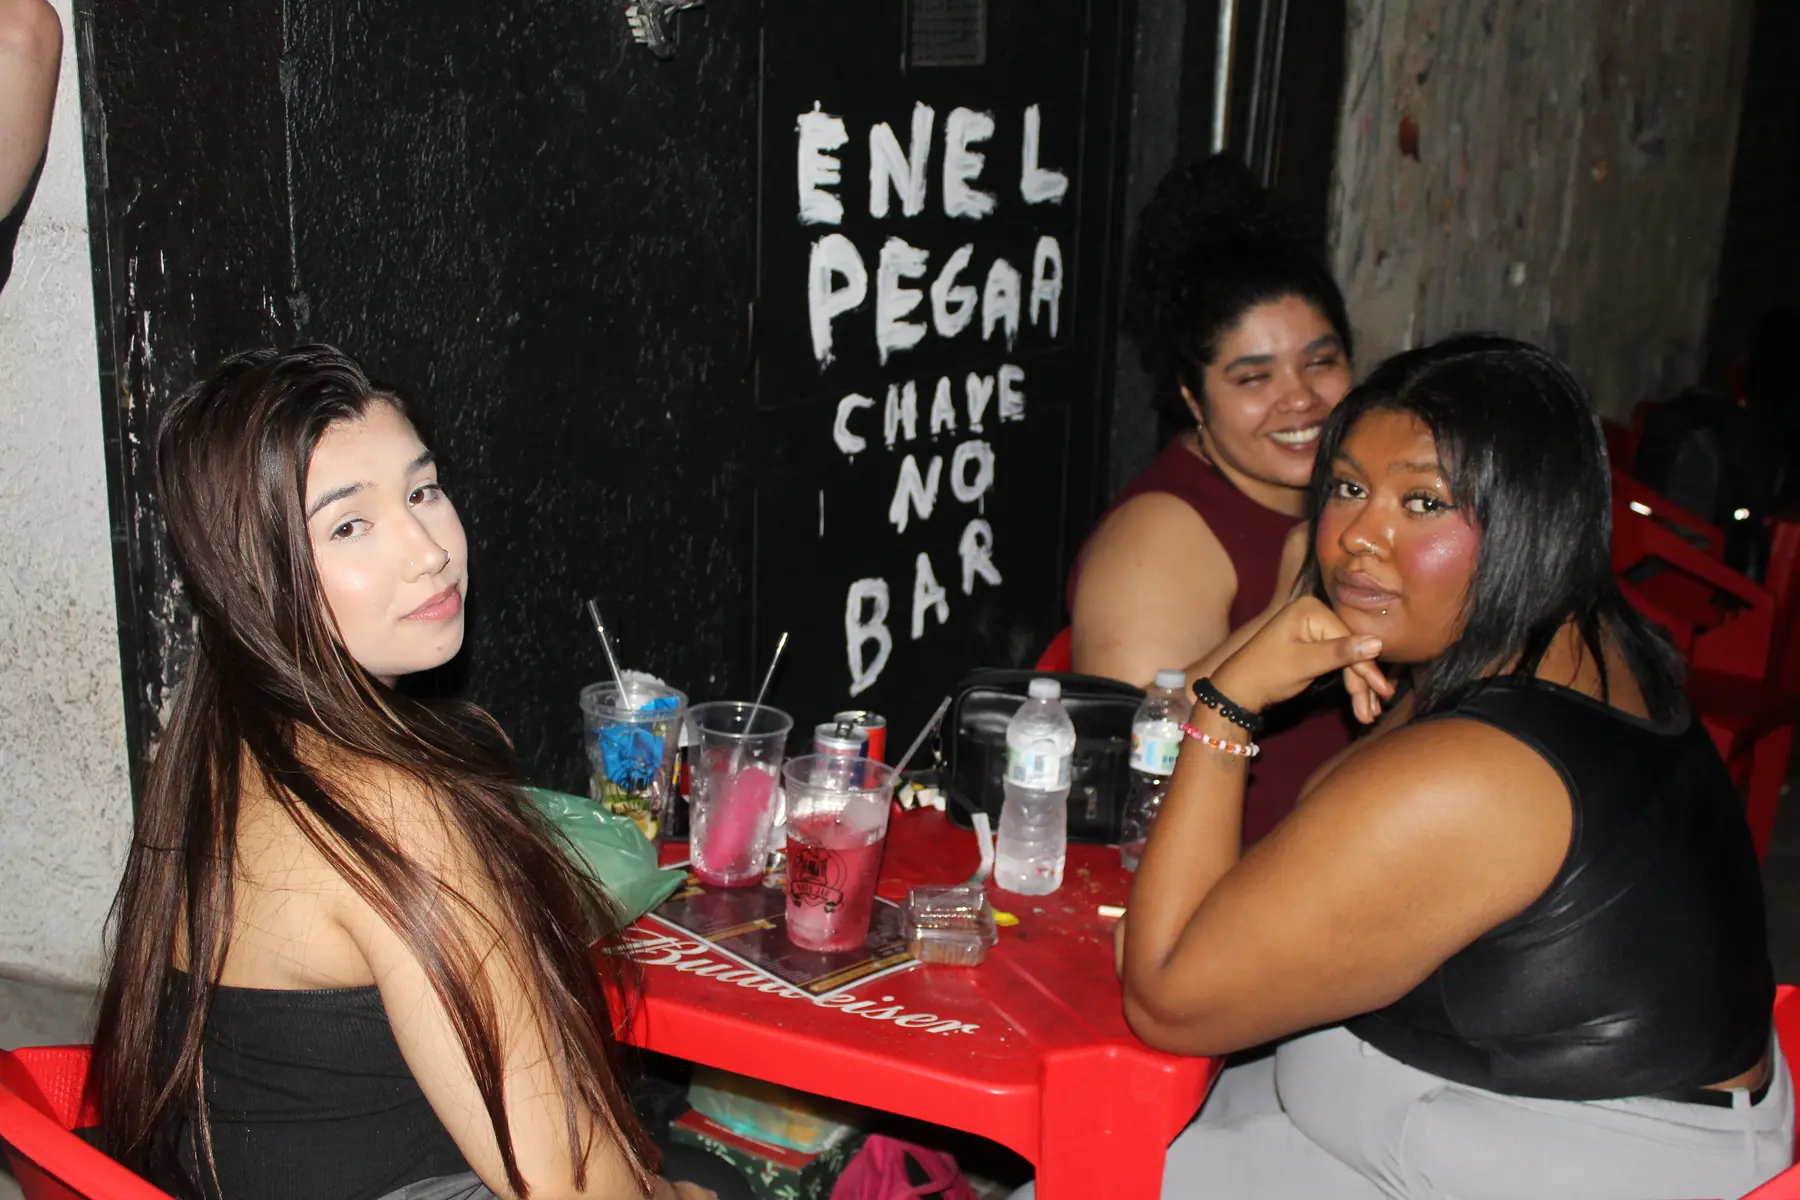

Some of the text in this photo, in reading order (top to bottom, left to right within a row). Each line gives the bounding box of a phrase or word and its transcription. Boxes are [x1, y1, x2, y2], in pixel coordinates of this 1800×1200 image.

[796, 100, 1068, 225] ENEL
[833, 364, 1025, 458] CHAVE
[889, 440, 995, 533] NO
[845, 519, 1002, 696] BAR
